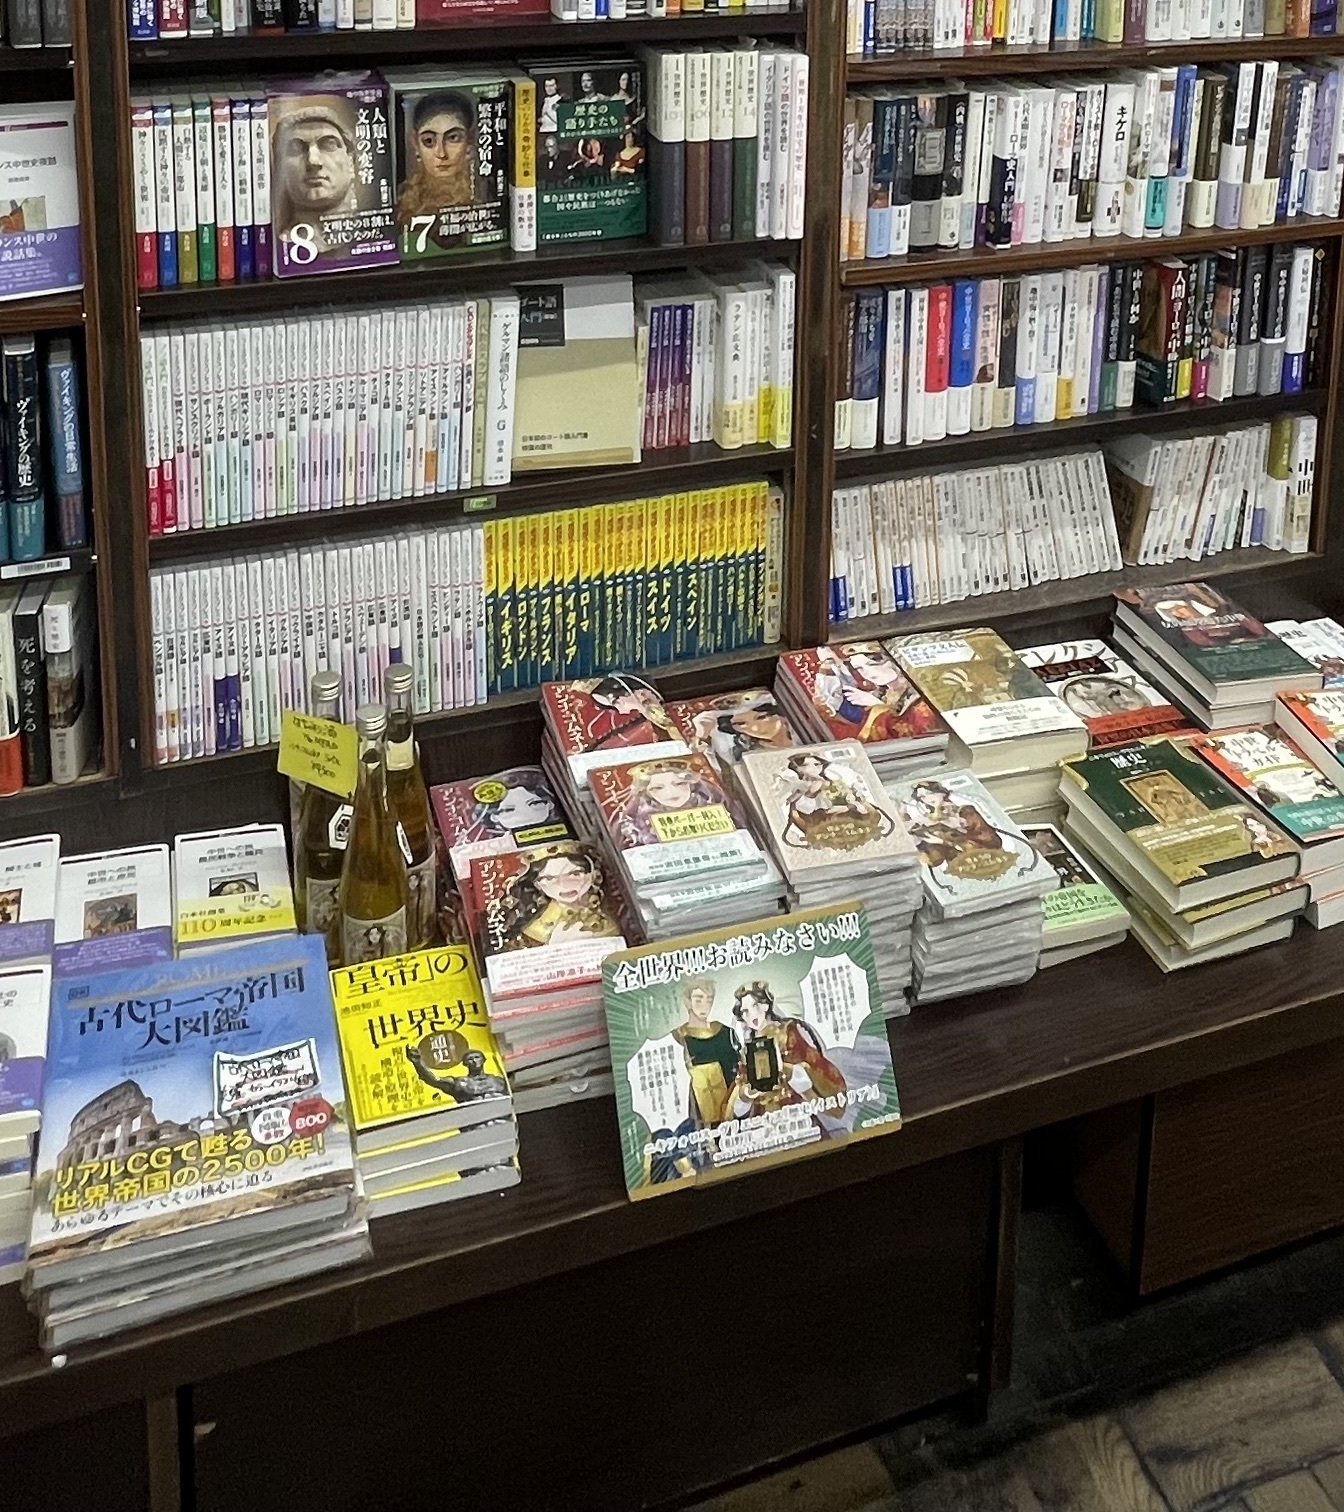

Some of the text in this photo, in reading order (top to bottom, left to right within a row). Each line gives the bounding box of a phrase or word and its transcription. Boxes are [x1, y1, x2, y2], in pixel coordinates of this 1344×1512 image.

[372, 107, 388, 154] 人類と
[494, 99, 506, 146] 平和と
[564, 115, 619, 131] 語り手たち
[573, 104, 608, 117] 歴史の
[1115, 105, 1127, 142] キケロ
[355, 108, 375, 185] 文明の変容
[478, 101, 492, 177] 繁栄の宿命
[289, 223, 319, 264] 8
[409, 214, 437, 254] 7
[16, 398, 36, 488] ヴァイキングの歴史
[580, 591, 590, 632] ローマ
[646, 580, 658, 634] スイス
[660, 576, 671, 632] ドイツ
[687, 572, 698, 630] スペイン
[501, 603, 514, 670] イギリス
[517, 602, 527, 660] ロンドン
[541, 596, 552, 666] フランス
[565, 591, 577, 666] イタリア
[18, 637, 37, 733] 死を考える
[1110, 752, 1147, 770] 歴史
[178, 919, 214, 936] 110
[479, 860, 509, 950] アンナ・コムネナ
[78, 968, 306, 1036] 古代ローマ帝国
[332, 953, 469, 999] 「皇帝」の
[142, 1011, 250, 1051] 大図鑑
[365, 999, 487, 1049] 世界史
[295, 1112, 328, 1129] 800
[55, 1129, 252, 1191] リアルCGで甦る
